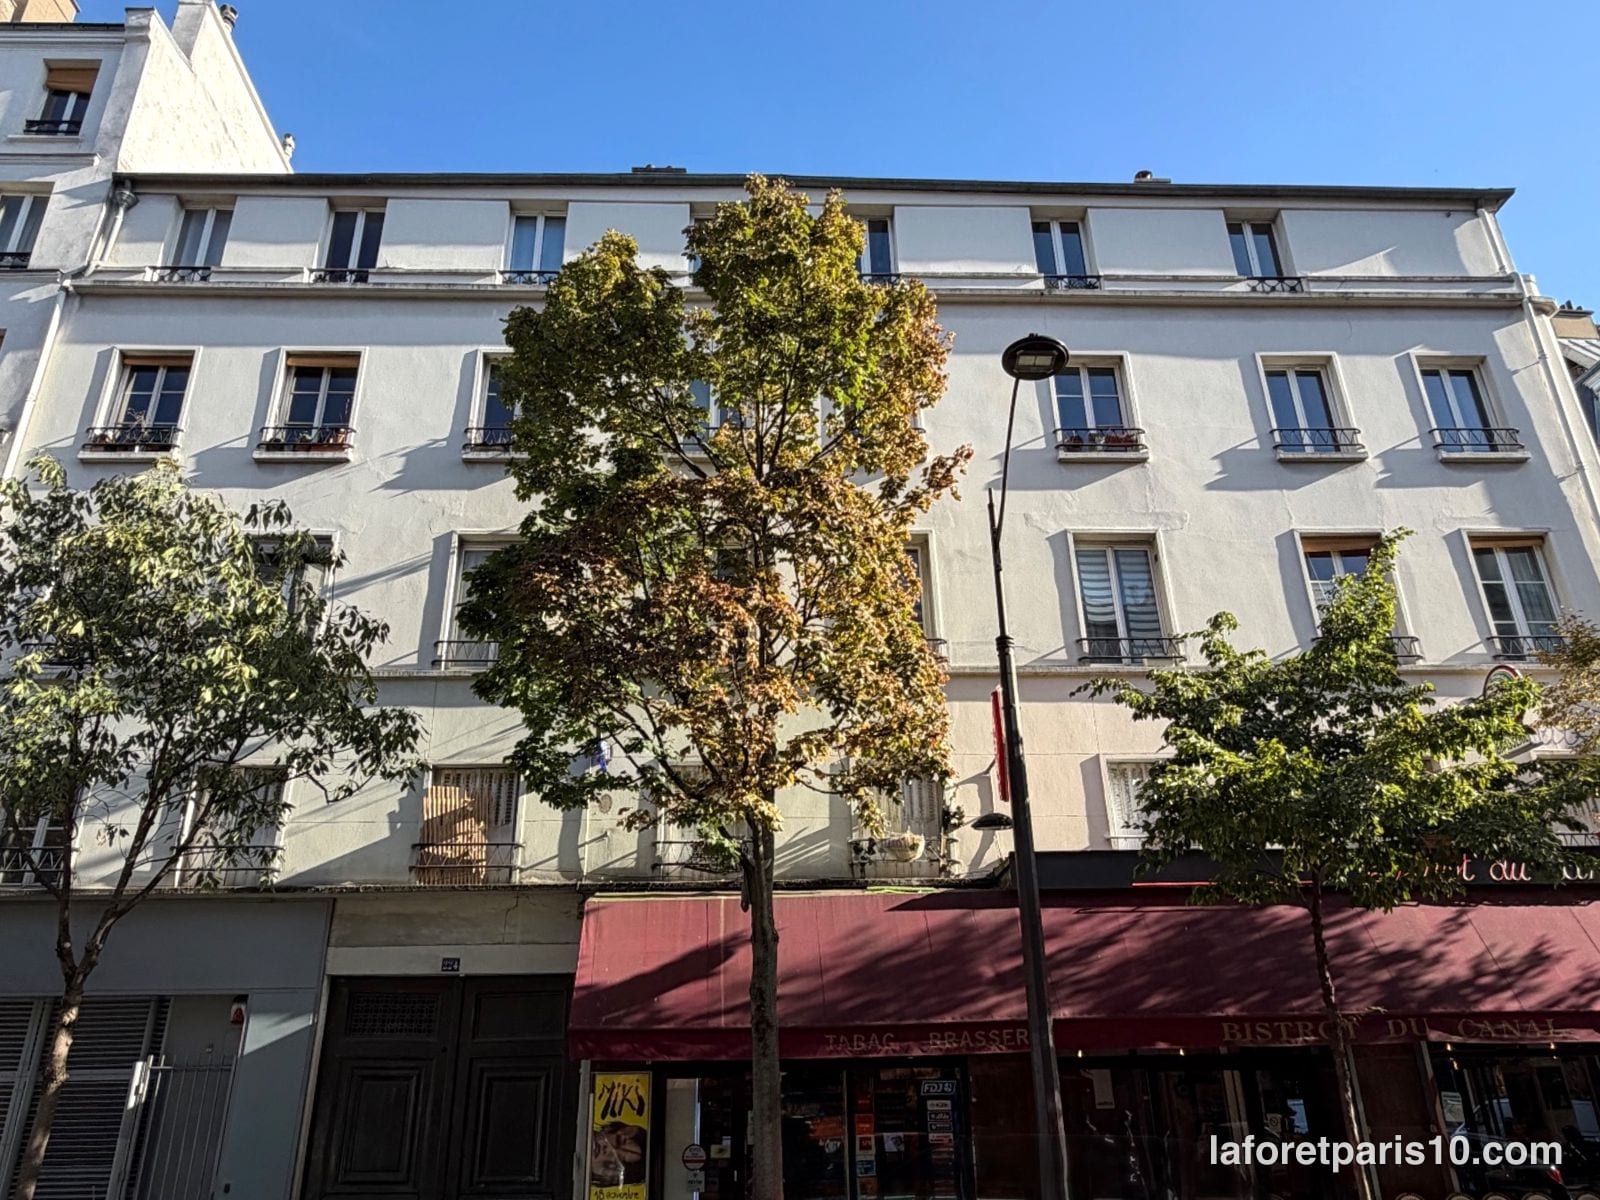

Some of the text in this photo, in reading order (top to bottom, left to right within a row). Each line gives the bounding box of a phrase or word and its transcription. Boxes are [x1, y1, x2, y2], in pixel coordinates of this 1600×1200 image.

[1489, 859, 1532, 881] du
[1386, 1018, 1429, 1038] DU
[1457, 1018, 1567, 1038] CANAL
[825, 1028, 1030, 1050] TABAC BRASSER
[923, 1082, 943, 1093] FDJ
